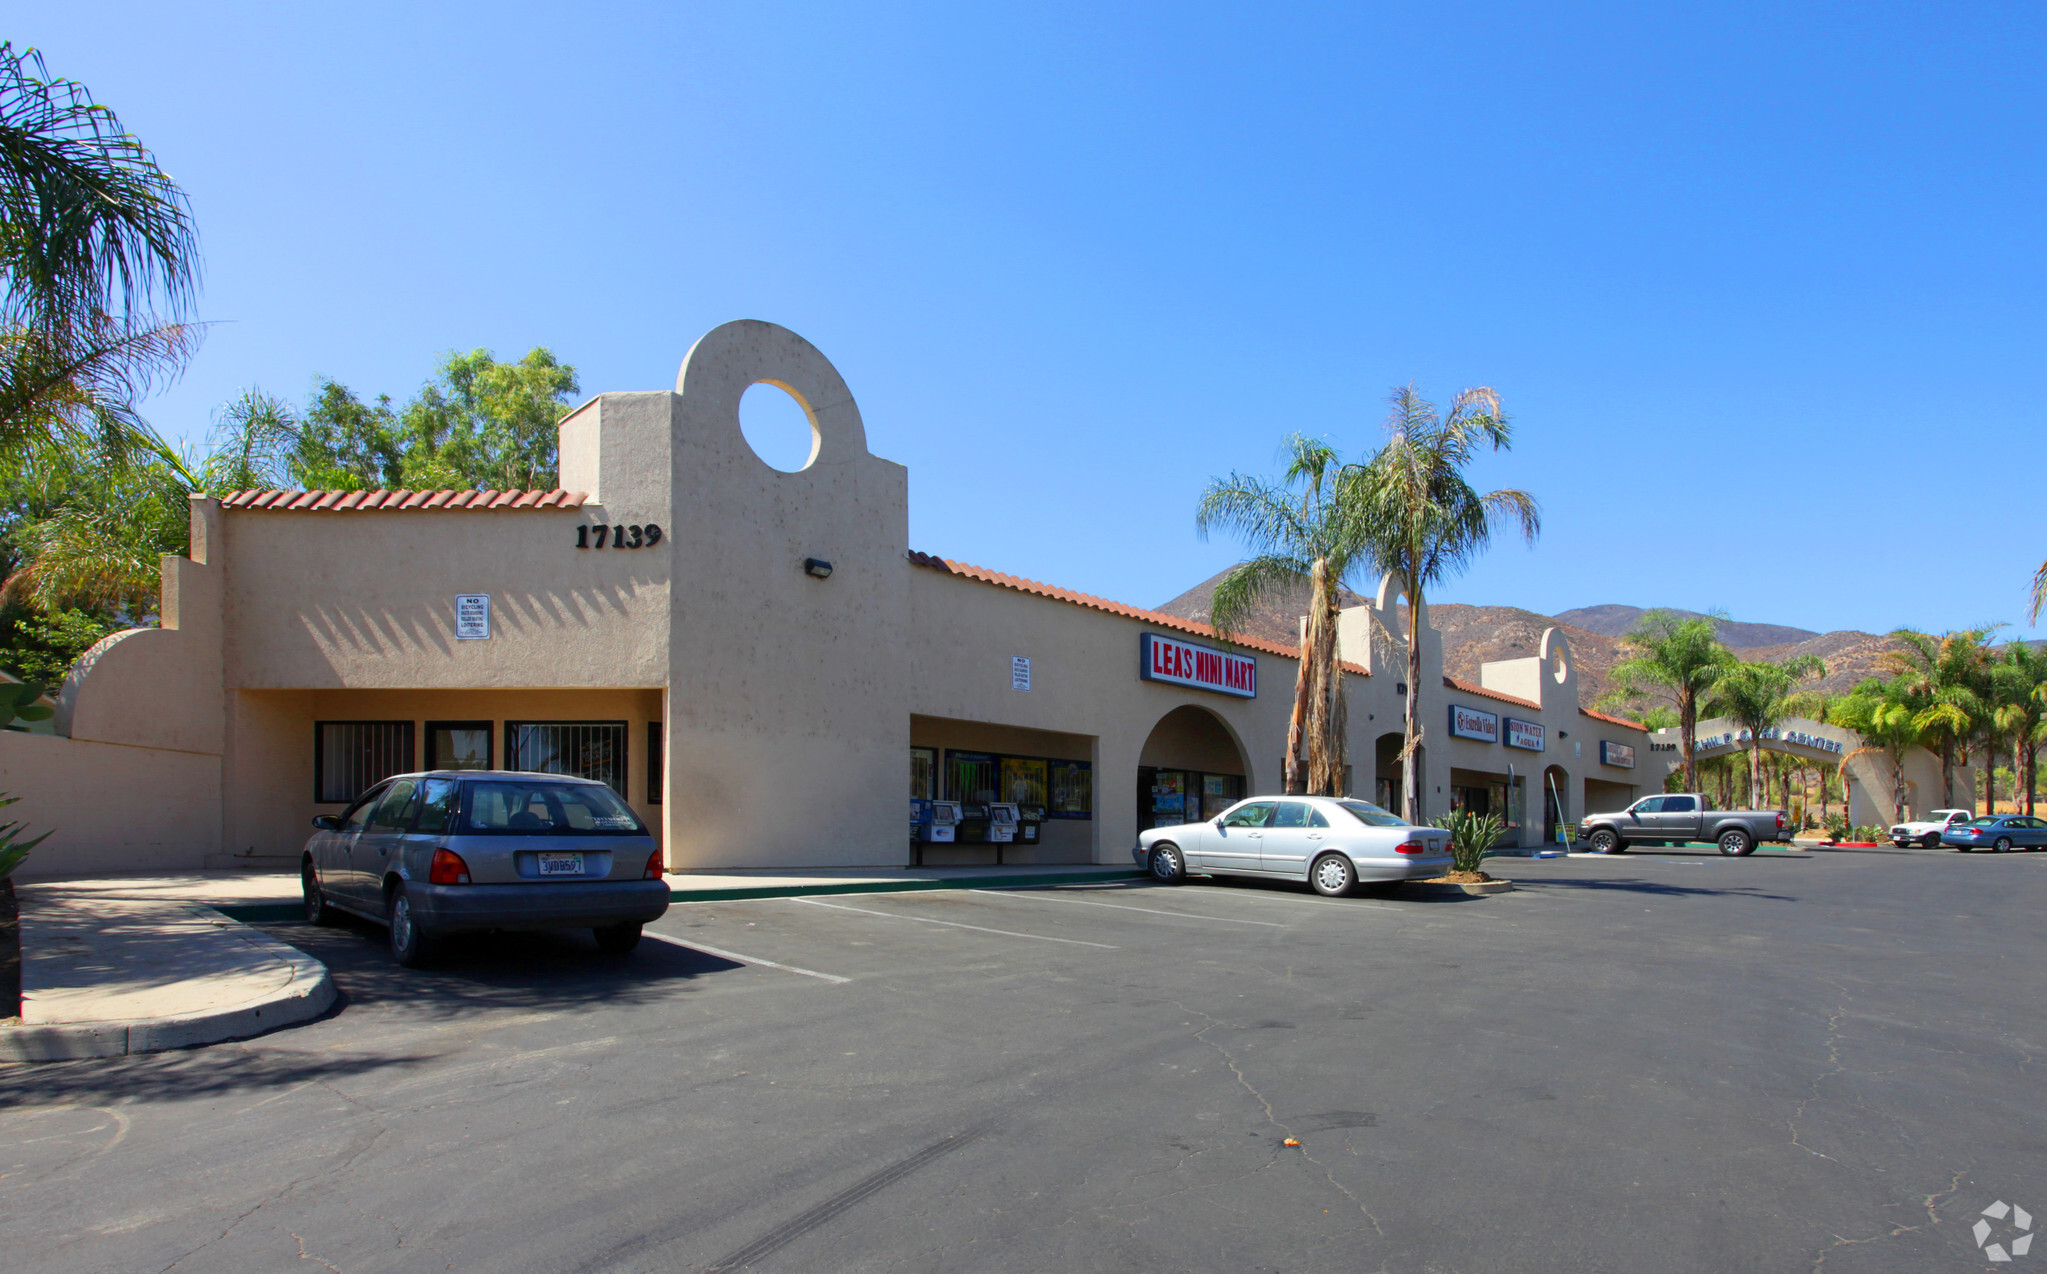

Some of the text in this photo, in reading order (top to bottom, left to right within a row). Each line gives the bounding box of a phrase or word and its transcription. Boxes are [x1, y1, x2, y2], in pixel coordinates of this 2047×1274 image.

[576, 523, 662, 549] 17139
[1153, 641, 1254, 692] LEA'S MINI MART
[1465, 715, 1496, 735] Estrella Video
[1510, 721, 1543, 738] SION WATER
[1519, 738, 1536, 748] AGUA
[1787, 730, 1844, 755] CENTER
